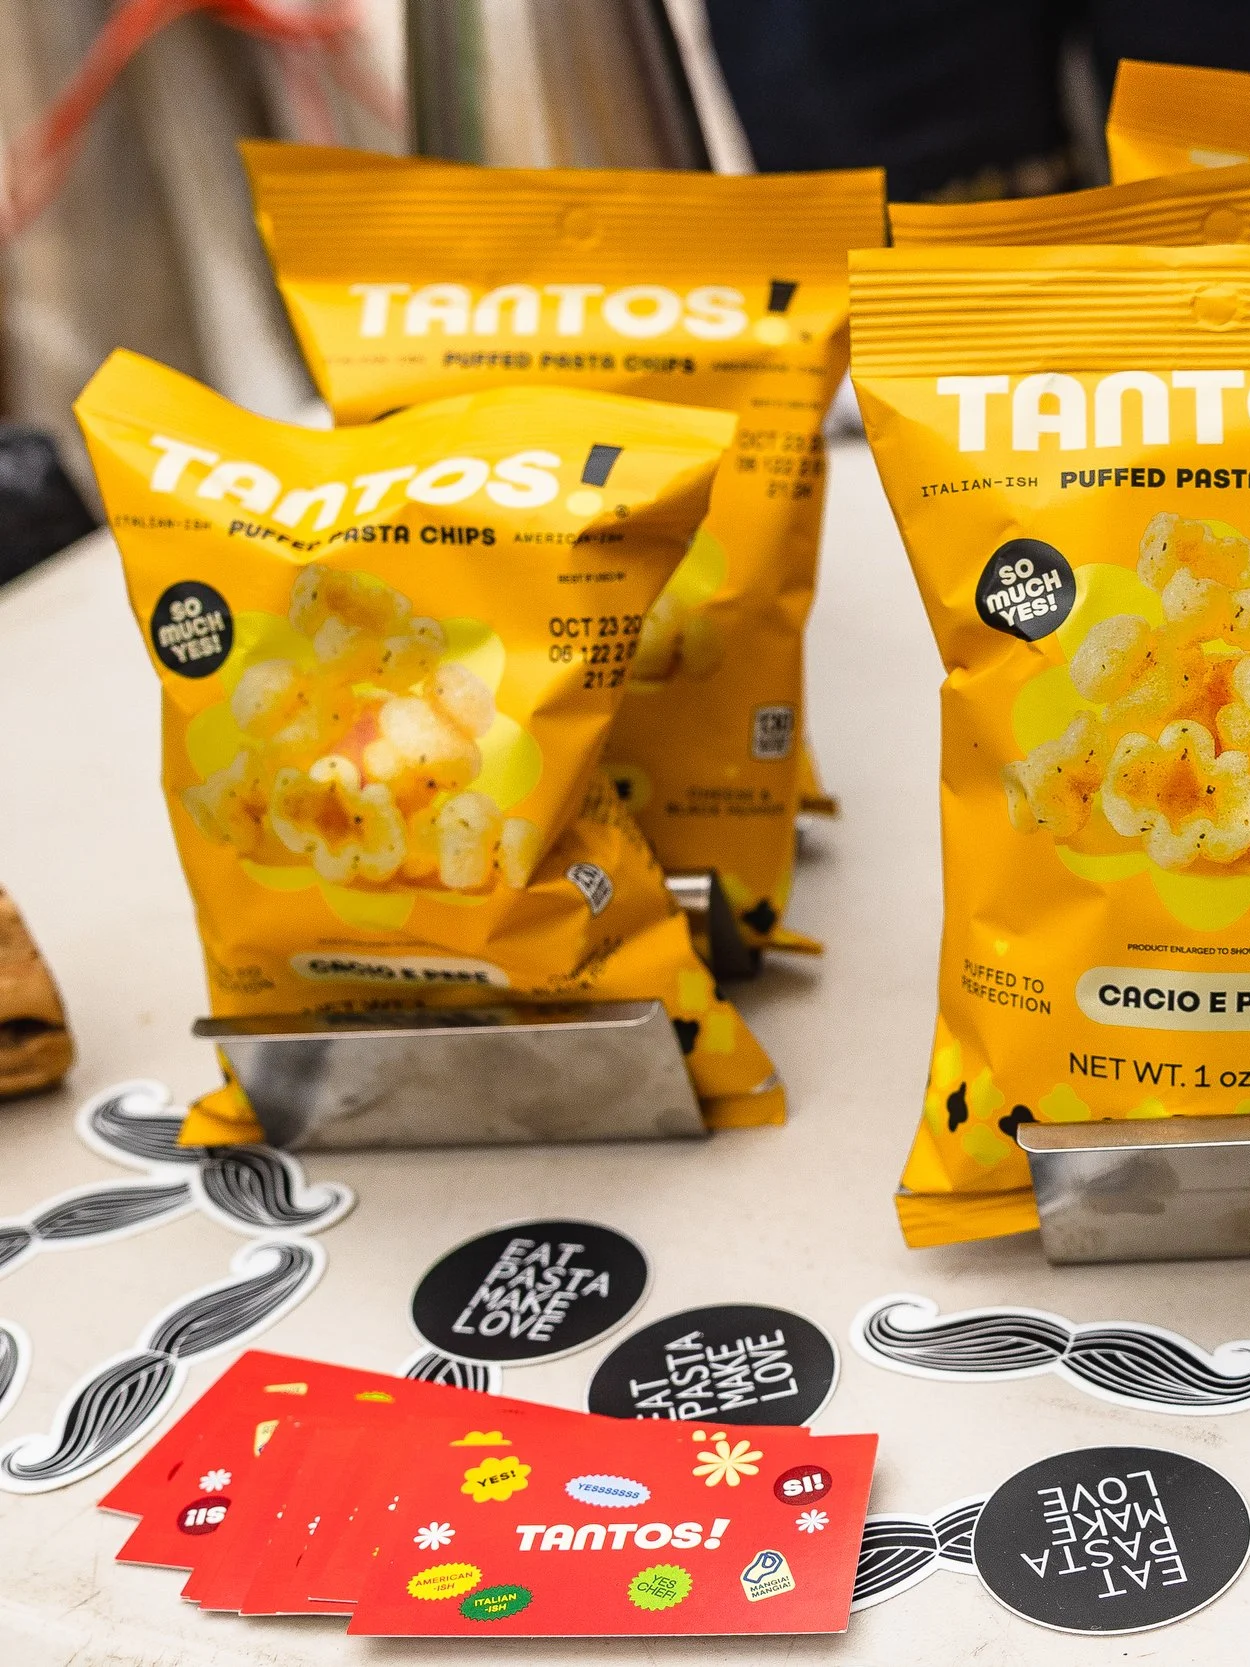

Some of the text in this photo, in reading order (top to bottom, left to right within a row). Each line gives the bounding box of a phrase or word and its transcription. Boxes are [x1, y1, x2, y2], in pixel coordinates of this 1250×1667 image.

[348, 279, 798, 346] TANTOS!
[149, 434, 624, 532] TANTOS!
[922, 476, 1038, 498] ITALIAN-ISH
[1060, 468, 1166, 489] PUFFED
[421, 525, 496, 546] CHIPS
[999, 558, 1034, 586] SO
[986, 569, 1063, 614] MUCH
[169, 596, 202, 623] SO
[999, 593, 1058, 627] YES!
[158, 610, 225, 647] MUCH
[549, 617, 593, 638] OCT
[599, 615, 619, 637] 23
[170, 633, 222, 663] YES!
[1127, 943, 1168, 952] PRODUCT
[1170, 945, 1215, 955] ENLARGED
[1218, 947, 1228, 955] TO
[964, 959, 1044, 994] PUFFED TO
[961, 975, 1051, 1015] PERFECTION
[1098, 984, 1201, 1013] CACIO
[1209, 991, 1227, 1013] E
[1069, 1052, 1126, 1080] NET
[1133, 1060, 1186, 1088] WT.
[1194, 1065, 1211, 1088] 1
[500, 1238, 585, 1268] EAT
[484, 1261, 610, 1298] PASTA
[468, 1284, 579, 1318] MAKE
[452, 1307, 564, 1342] LOVE
[664, 1330, 719, 1420] PASTA
[705, 1338, 759, 1411] MAKE
[744, 1329, 799, 1402] LOVE
[477, 1470, 516, 1488] YES!
[783, 1473, 825, 1497] SI!
[1037, 1470, 1159, 1517] LOVE
[516, 1518, 731, 1551] TANTOS!
[1045, 1497, 1168, 1546] MAKE
[1020, 1526, 1178, 1578] PASTA
[415, 1571, 474, 1587] AMERICAN
[433, 1583, 455, 1592] -ISH
[637, 1582, 677, 1601] CHEF!
[652, 1574, 677, 1589] YES
[750, 1576, 790, 1593] MANGIA!
[751, 1582, 791, 1599] MANGIA!
[1098, 1554, 1188, 1599] EAT
[474, 1593, 517, 1607] ITALIAN
[484, 1603, 507, 1614] -ISH
